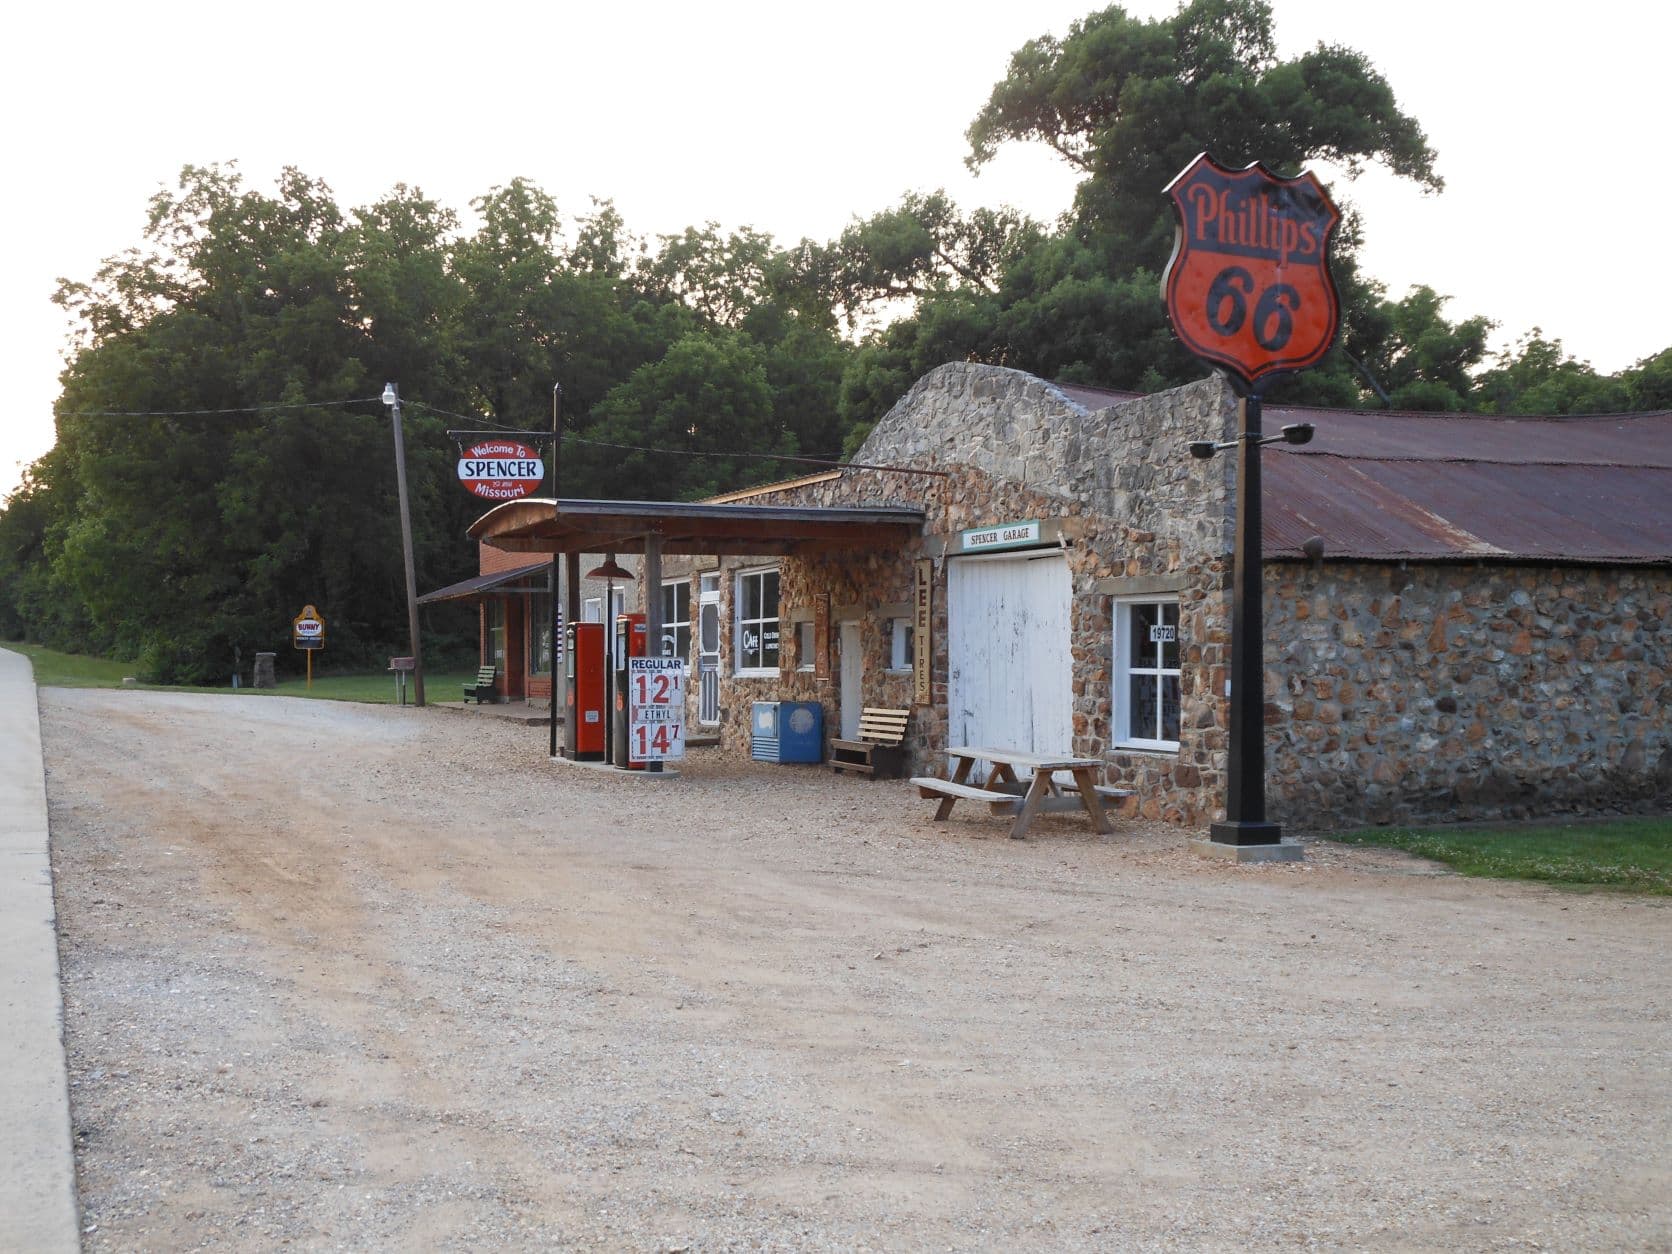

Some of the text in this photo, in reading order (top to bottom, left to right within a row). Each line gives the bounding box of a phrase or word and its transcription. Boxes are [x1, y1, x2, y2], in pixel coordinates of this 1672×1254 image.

[1187, 182, 1317, 269] Phillips
[1206, 265, 1301, 352] 66
[471, 443, 526, 458] Welcome To
[465, 461, 536, 477] SPENCER
[474, 483, 525, 498] Missouri
[971, 527, 1029, 545] SPENCER GARAGE
[918, 569, 926, 628] LEE
[1153, 627, 1174, 639] 19720
[631, 659, 681, 670] REGULAR
[645, 709, 671, 720] ETHYL
